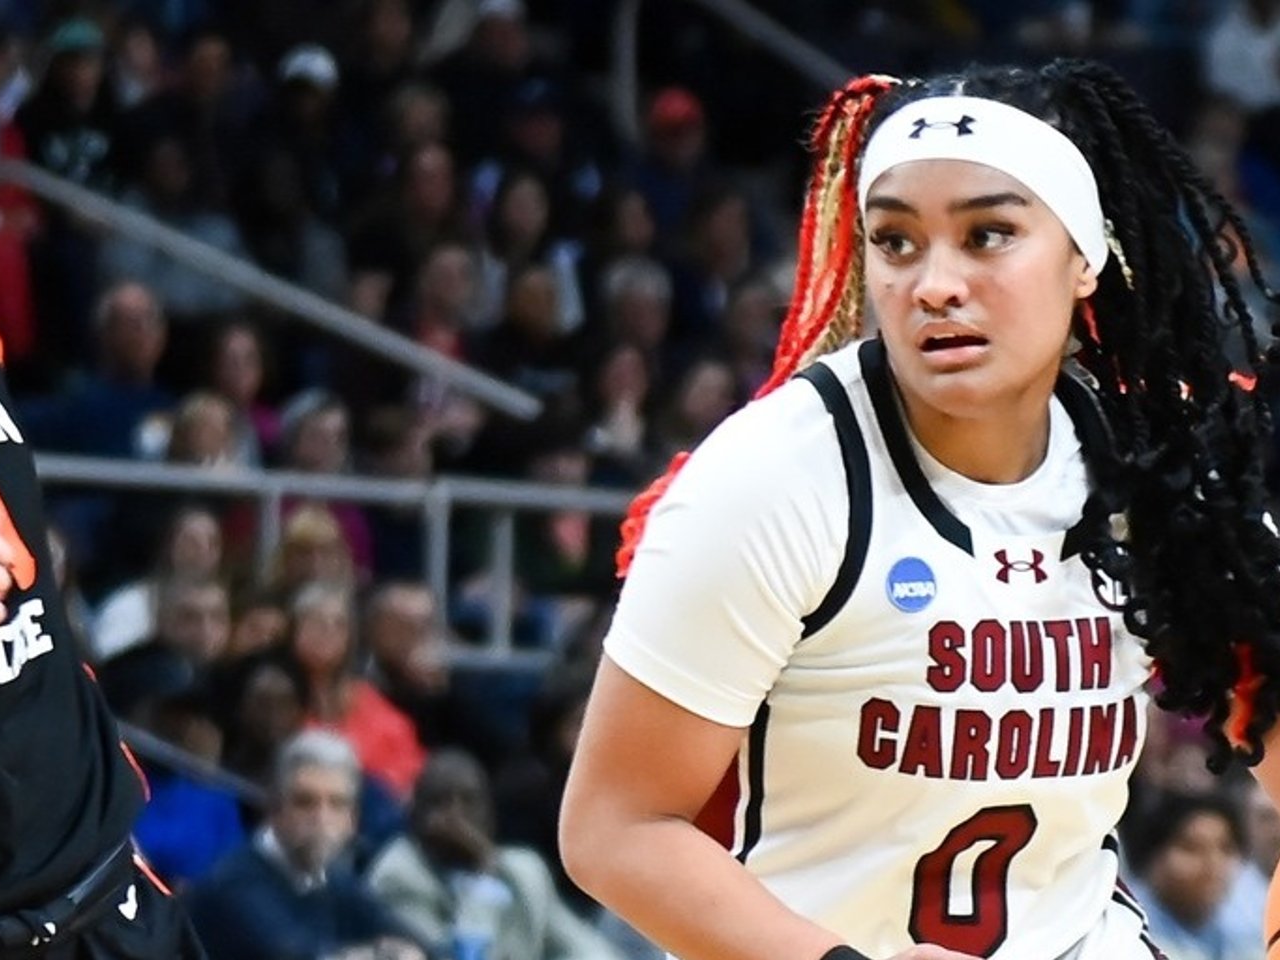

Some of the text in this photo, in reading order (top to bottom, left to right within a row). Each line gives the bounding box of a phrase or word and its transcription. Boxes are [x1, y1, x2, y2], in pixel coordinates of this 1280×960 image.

[926, 616, 1112, 693] SOUTH
[856, 696, 1138, 781] CAROLINA
[908, 803, 1038, 960] 0
